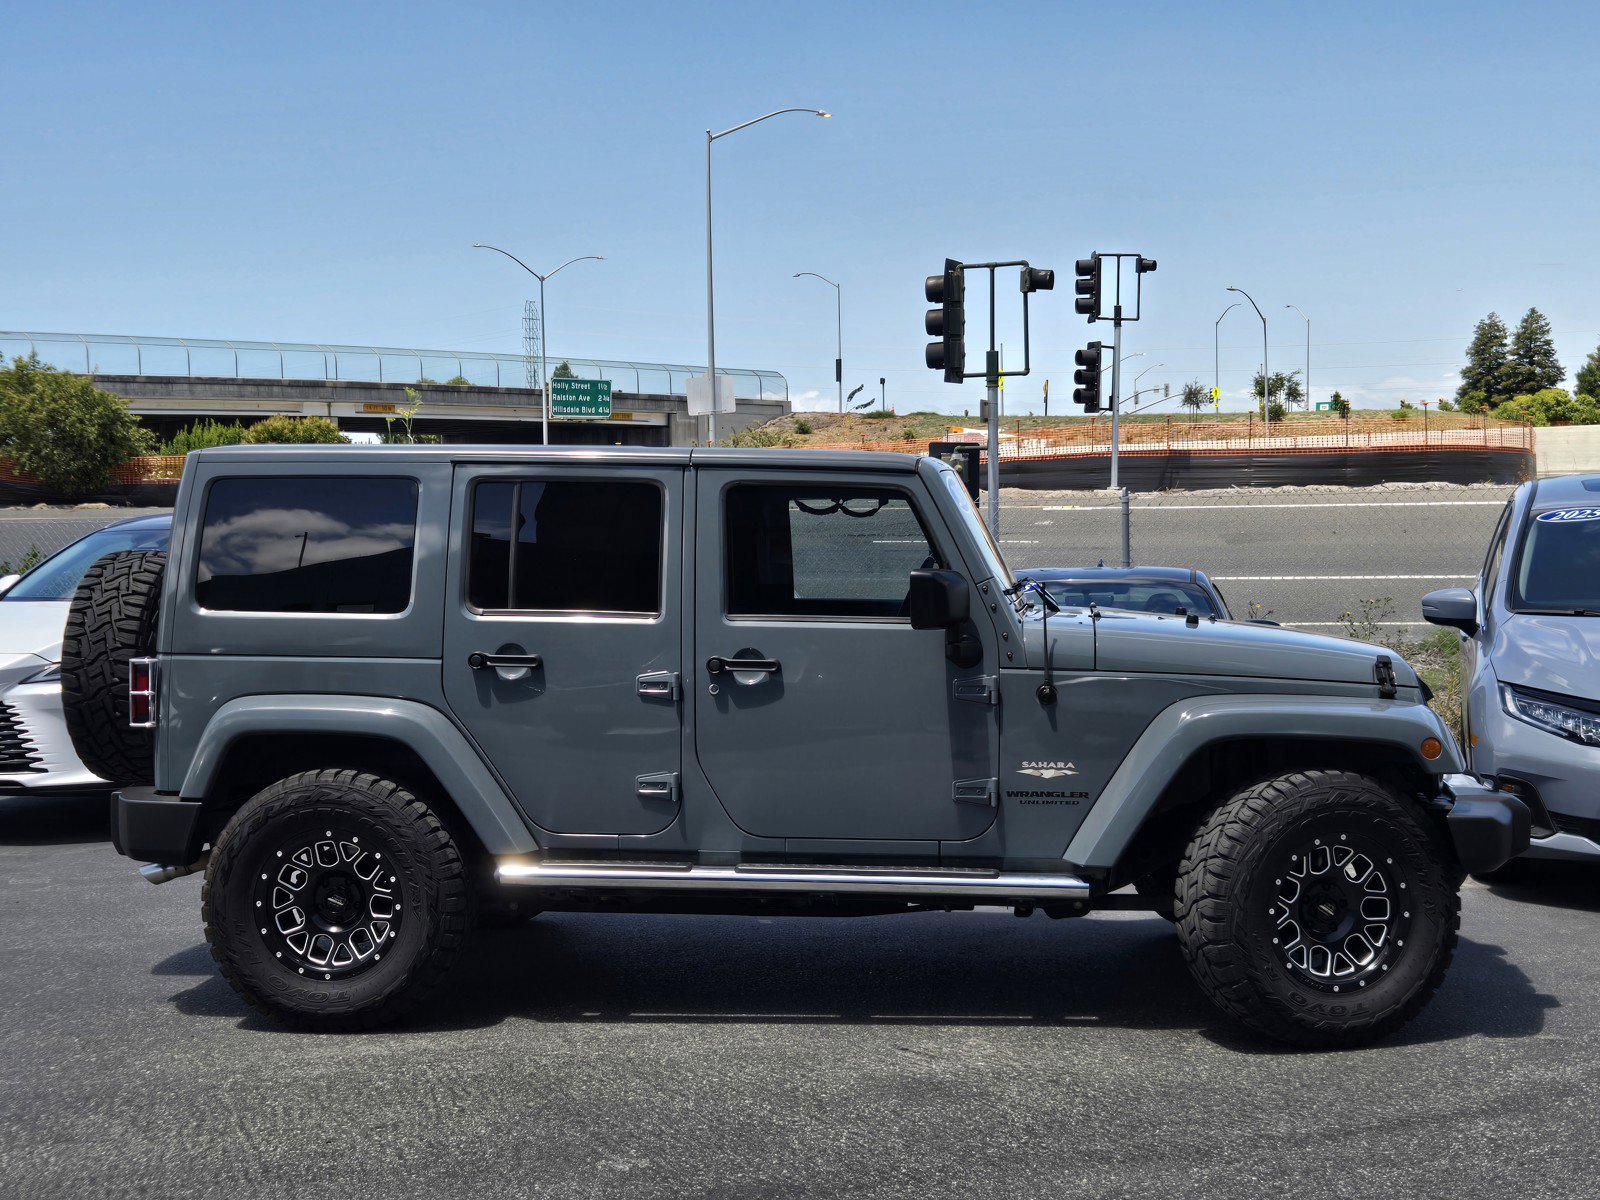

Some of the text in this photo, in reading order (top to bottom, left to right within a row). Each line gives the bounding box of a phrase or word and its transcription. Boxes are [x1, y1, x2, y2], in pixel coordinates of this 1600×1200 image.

[553, 382, 568, 390] Holly
[553, 393, 576, 401] Ralston
[1006, 790, 1089, 799] WRANGLER
[268, 975, 351, 1003] TOYO
[1288, 990, 1370, 1016] TOYO
